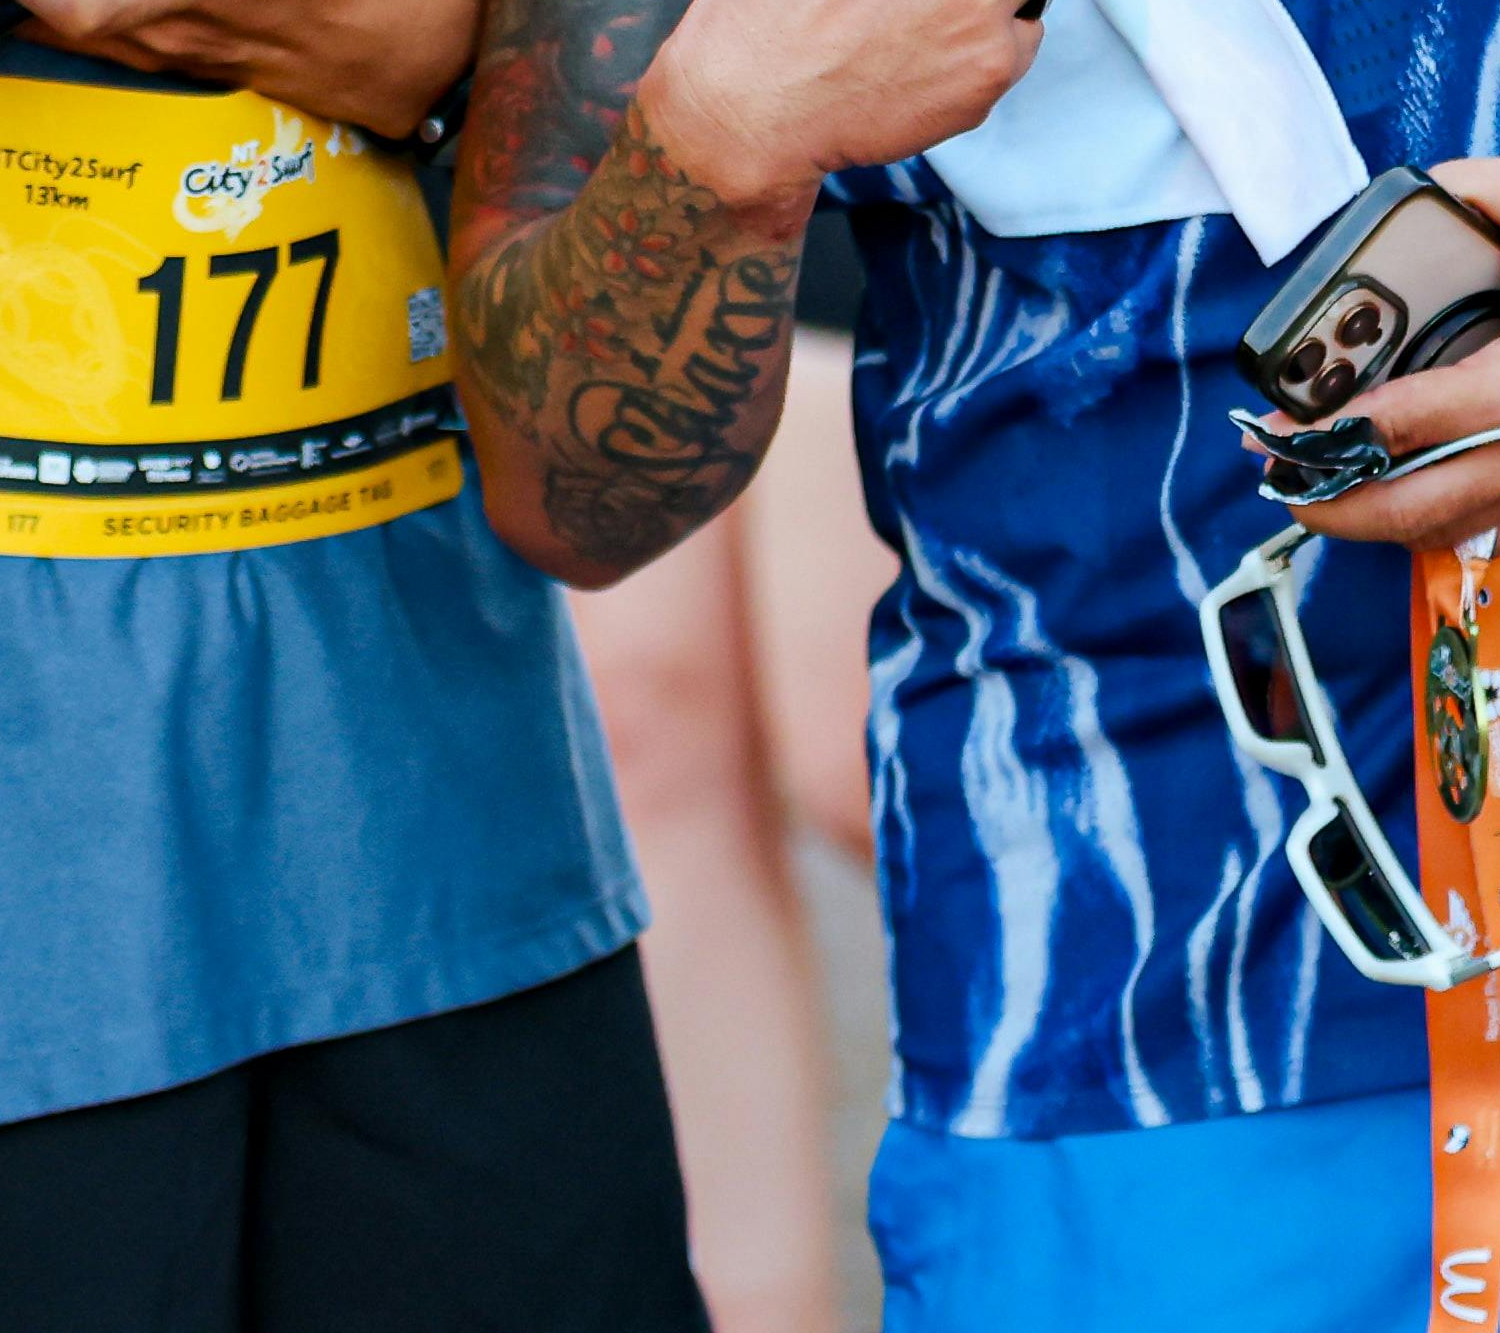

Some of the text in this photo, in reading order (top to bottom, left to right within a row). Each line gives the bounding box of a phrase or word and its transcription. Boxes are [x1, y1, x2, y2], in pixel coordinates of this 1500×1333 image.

[232, 139, 260, 162] NT
[137, 228, 341, 407] 177
[103, 509, 230, 538] SECURITY
[238, 489, 353, 526] BAGGAGE
